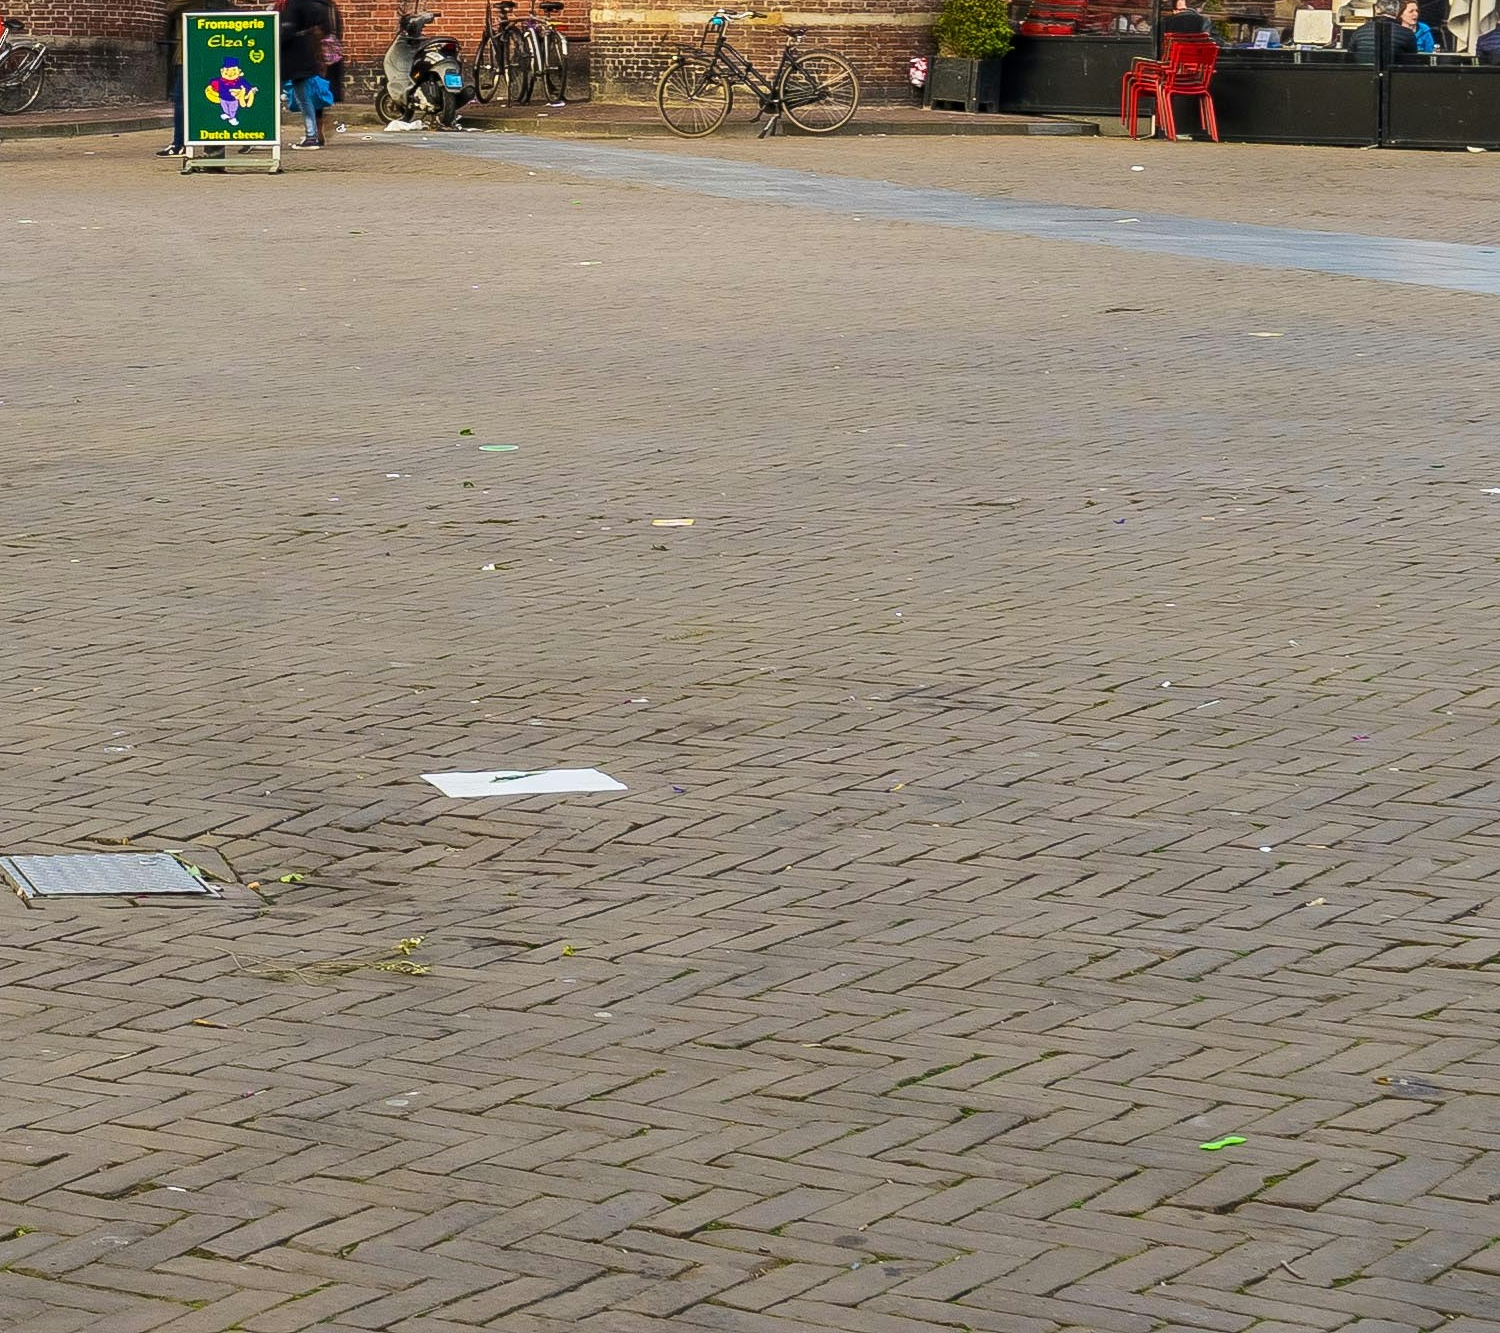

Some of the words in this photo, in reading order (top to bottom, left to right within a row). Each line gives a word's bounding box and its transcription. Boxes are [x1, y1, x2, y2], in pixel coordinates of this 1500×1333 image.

[197, 18, 265, 32] Fromagerie
[207, 34, 256, 48] Elza's
[200, 129, 231, 140] Dutch
[232, 130, 265, 140] cheese
